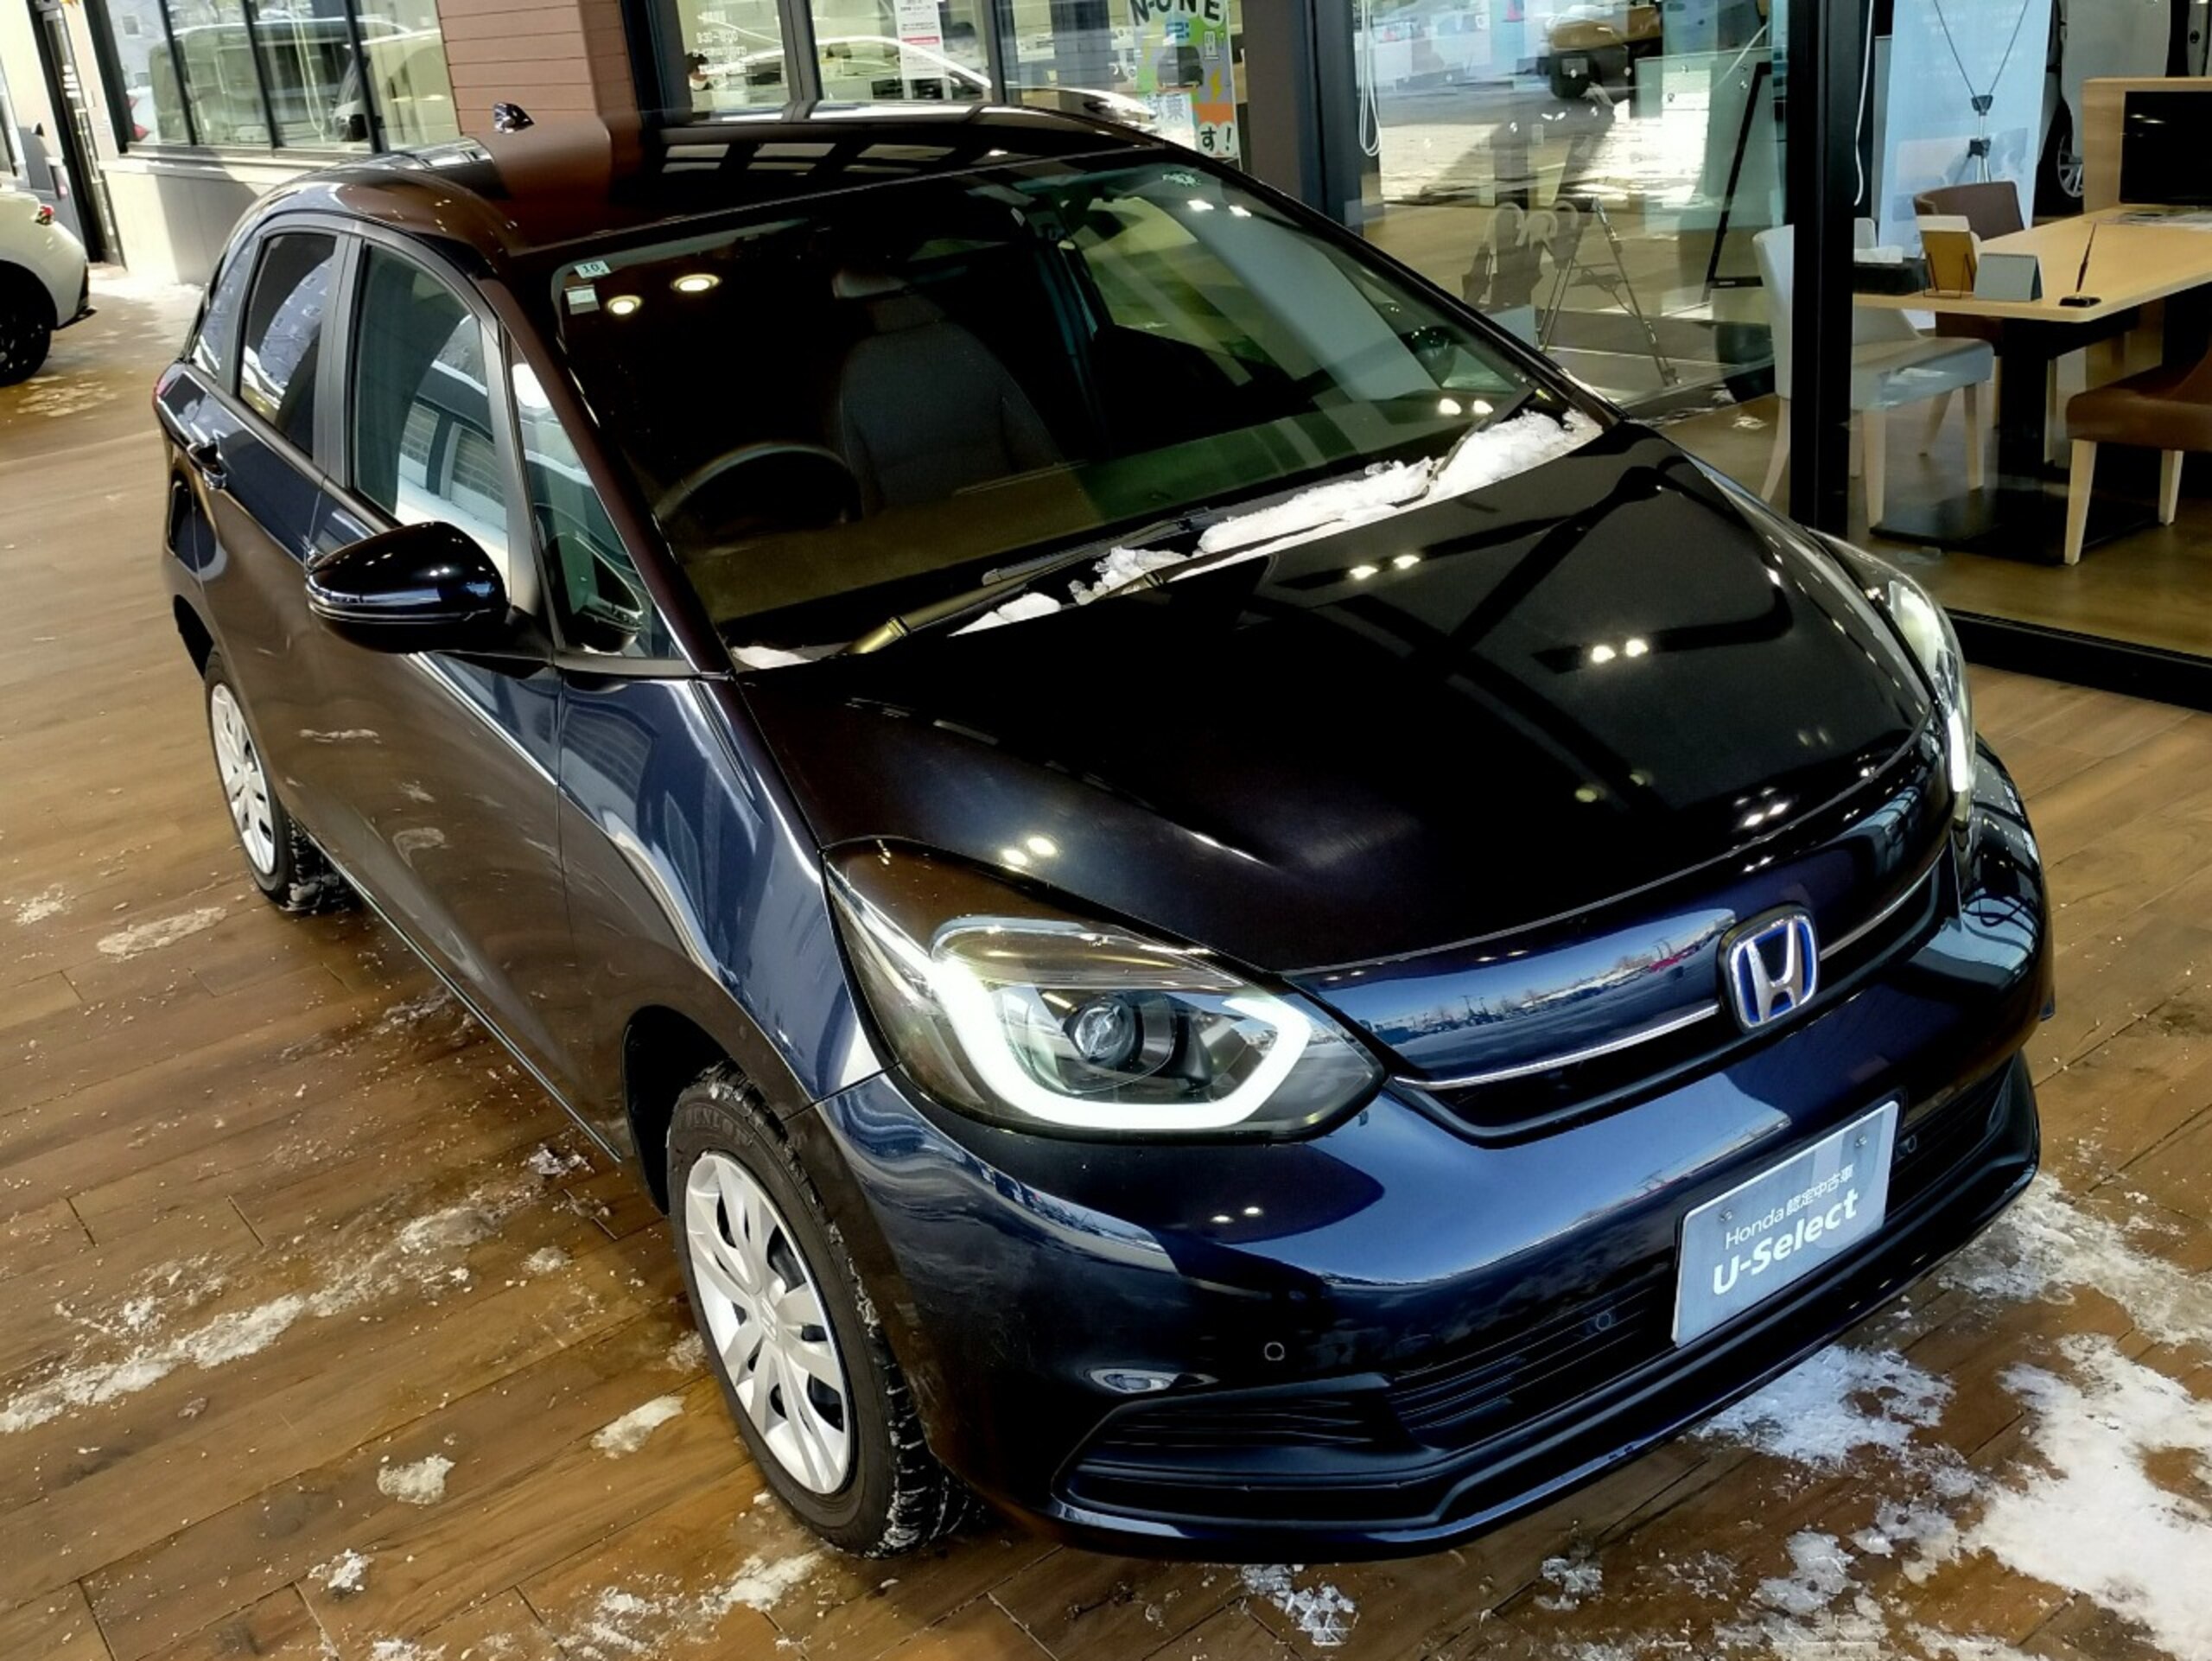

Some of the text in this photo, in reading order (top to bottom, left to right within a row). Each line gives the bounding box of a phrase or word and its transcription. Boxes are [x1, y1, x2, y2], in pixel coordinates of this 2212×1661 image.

[1713, 1187, 1859, 1295] U-Select
[1725, 1162, 1854, 1250] Honda 認定中古車
